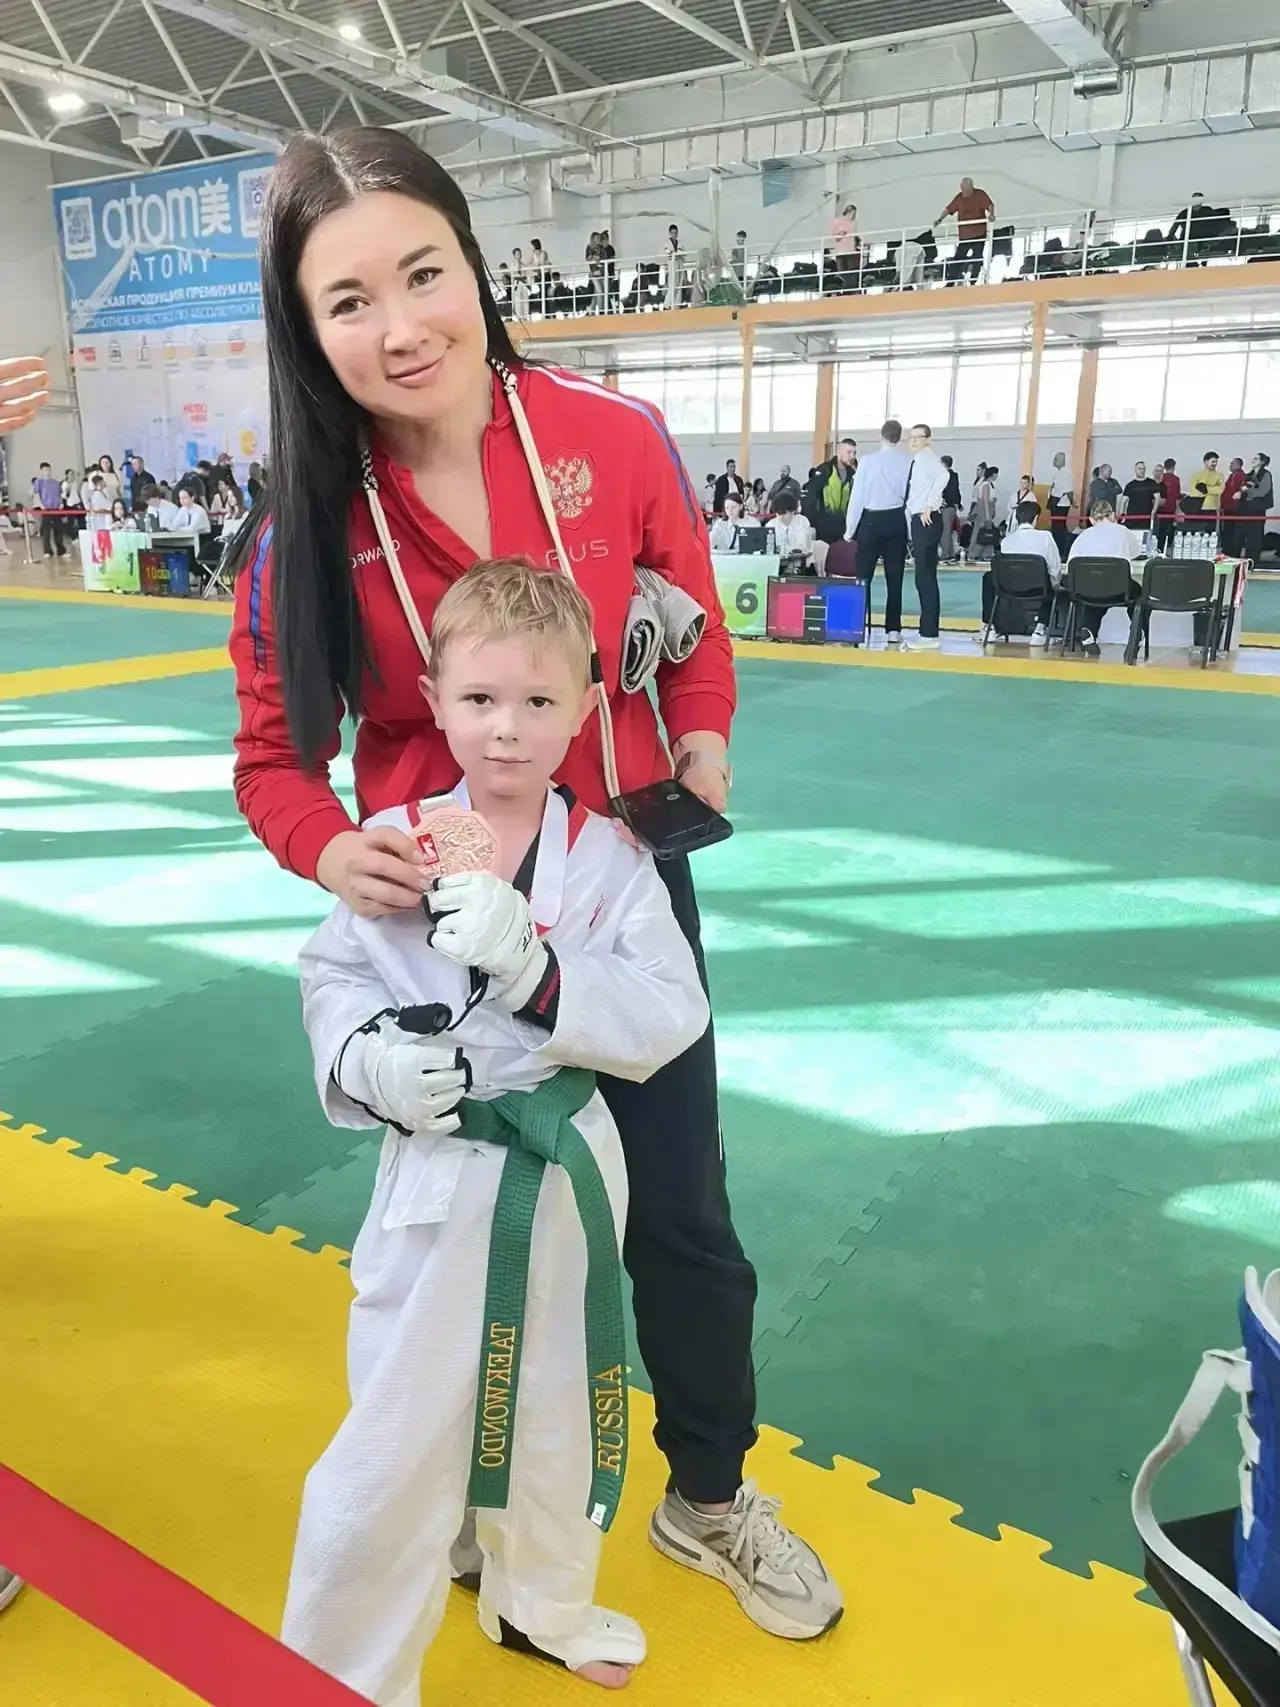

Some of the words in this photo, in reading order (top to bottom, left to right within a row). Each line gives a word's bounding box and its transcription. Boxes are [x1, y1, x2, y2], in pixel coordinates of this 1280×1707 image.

[128, 248, 210, 282] ATOMY
[126, 287, 185, 307] ПРОДУКЦИЯ
[185, 283, 237, 299] ПРЕМИУМ
[127, 552, 135, 576] 1
[348, 539, 401, 568] ORWAD
[545, 539, 609, 569] RUS
[735, 582, 758, 615] 6
[594, 1363, 623, 1476] RUSSIA
